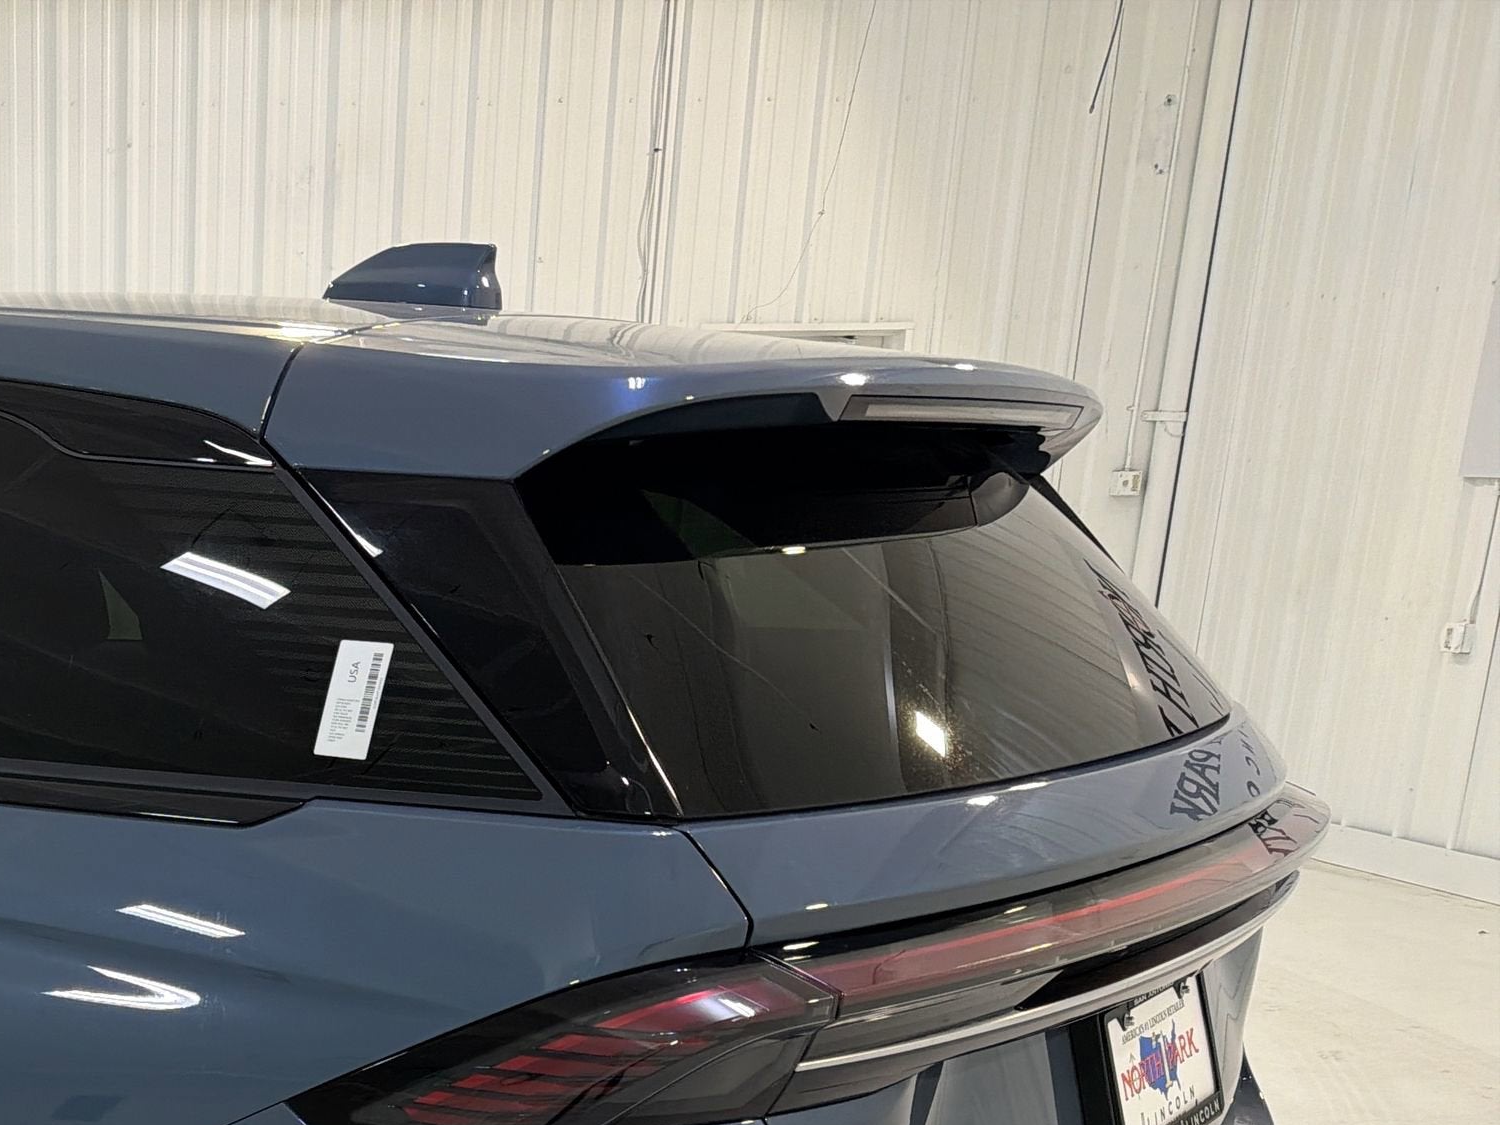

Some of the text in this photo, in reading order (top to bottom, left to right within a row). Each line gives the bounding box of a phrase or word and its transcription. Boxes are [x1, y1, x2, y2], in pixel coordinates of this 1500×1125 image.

[348, 661, 361, 683] USA
[1121, 1027, 1200, 1101] NORTH PARK
